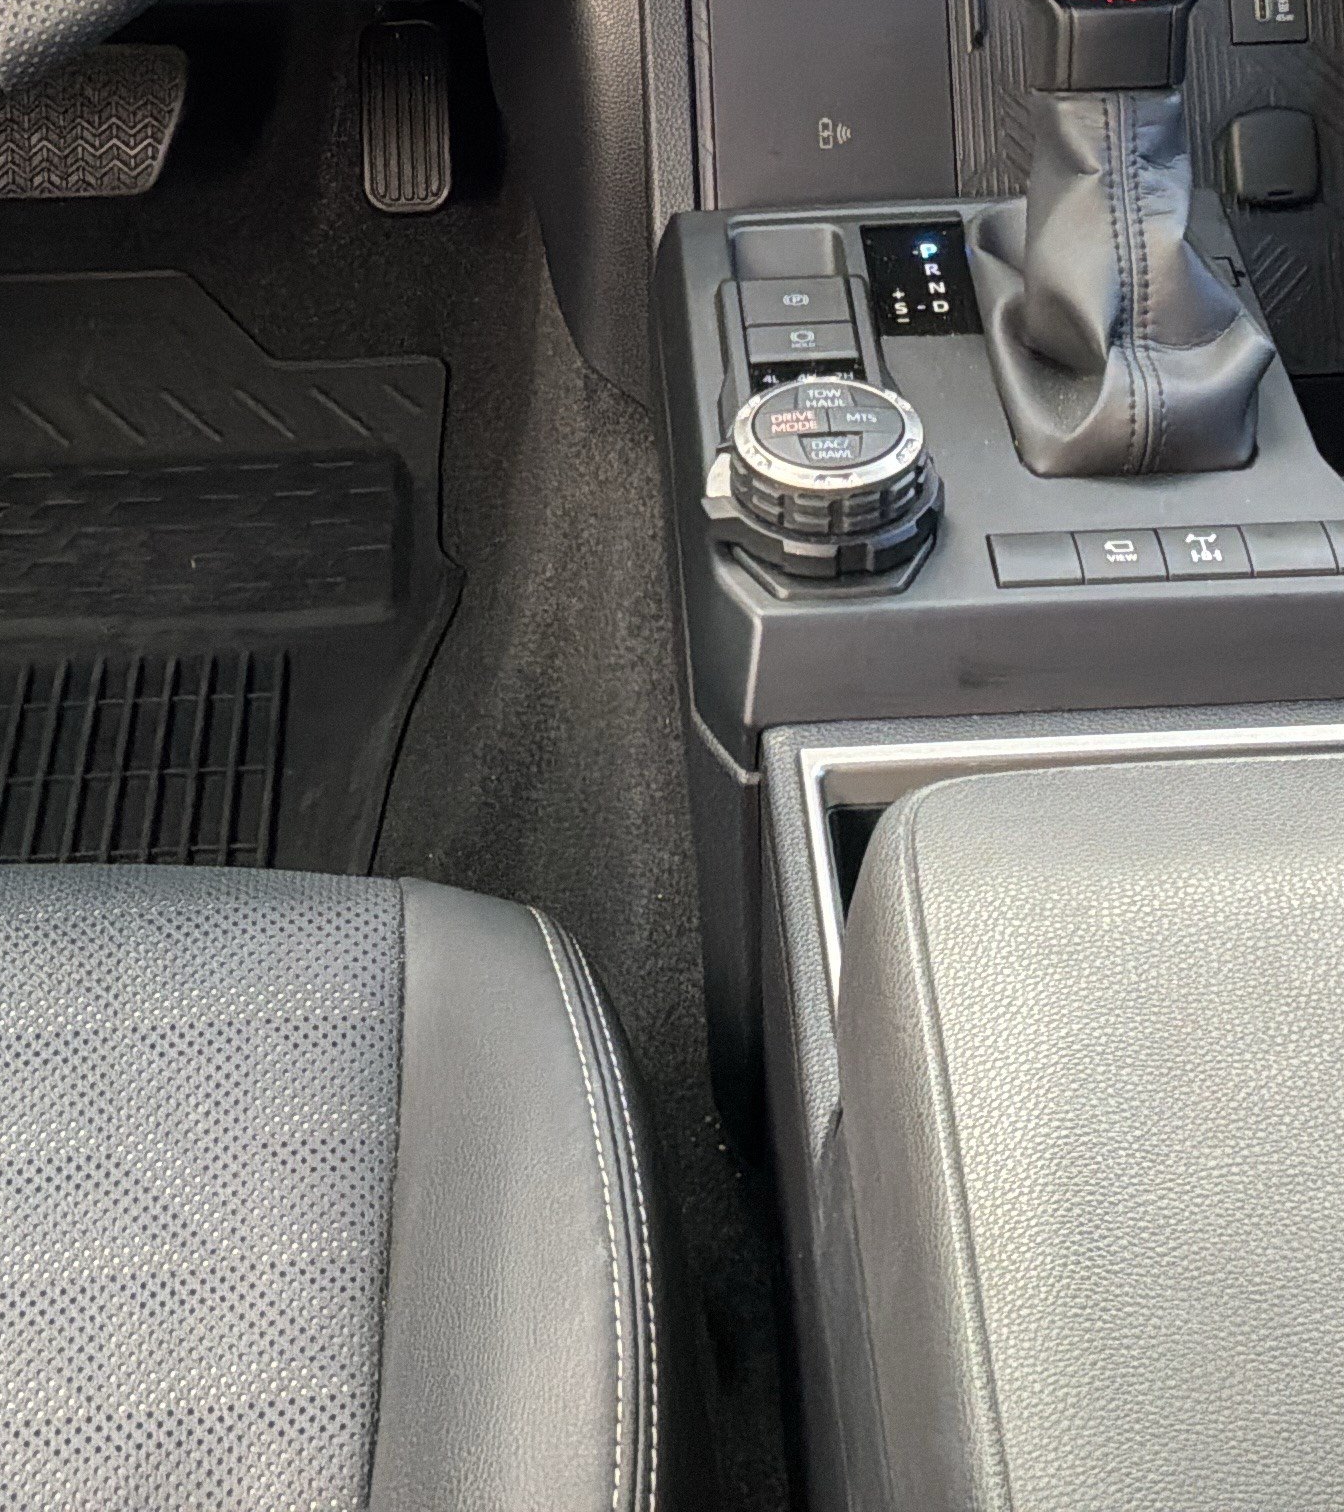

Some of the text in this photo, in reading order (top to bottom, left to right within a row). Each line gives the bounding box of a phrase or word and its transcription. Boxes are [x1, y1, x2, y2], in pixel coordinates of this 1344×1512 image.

[920, 243, 938, 259] P
[924, 263, 942, 276] R
[928, 281, 946, 294] N
[894, 301, 908, 315] S
[932, 300, 950, 313] D
[807, 388, 842, 398] TOW
[806, 398, 849, 409] HAUL
[770, 410, 817, 424] DRIVE
[771, 422, 819, 434] MODE
[1106, 553, 1138, 563] VIEW
